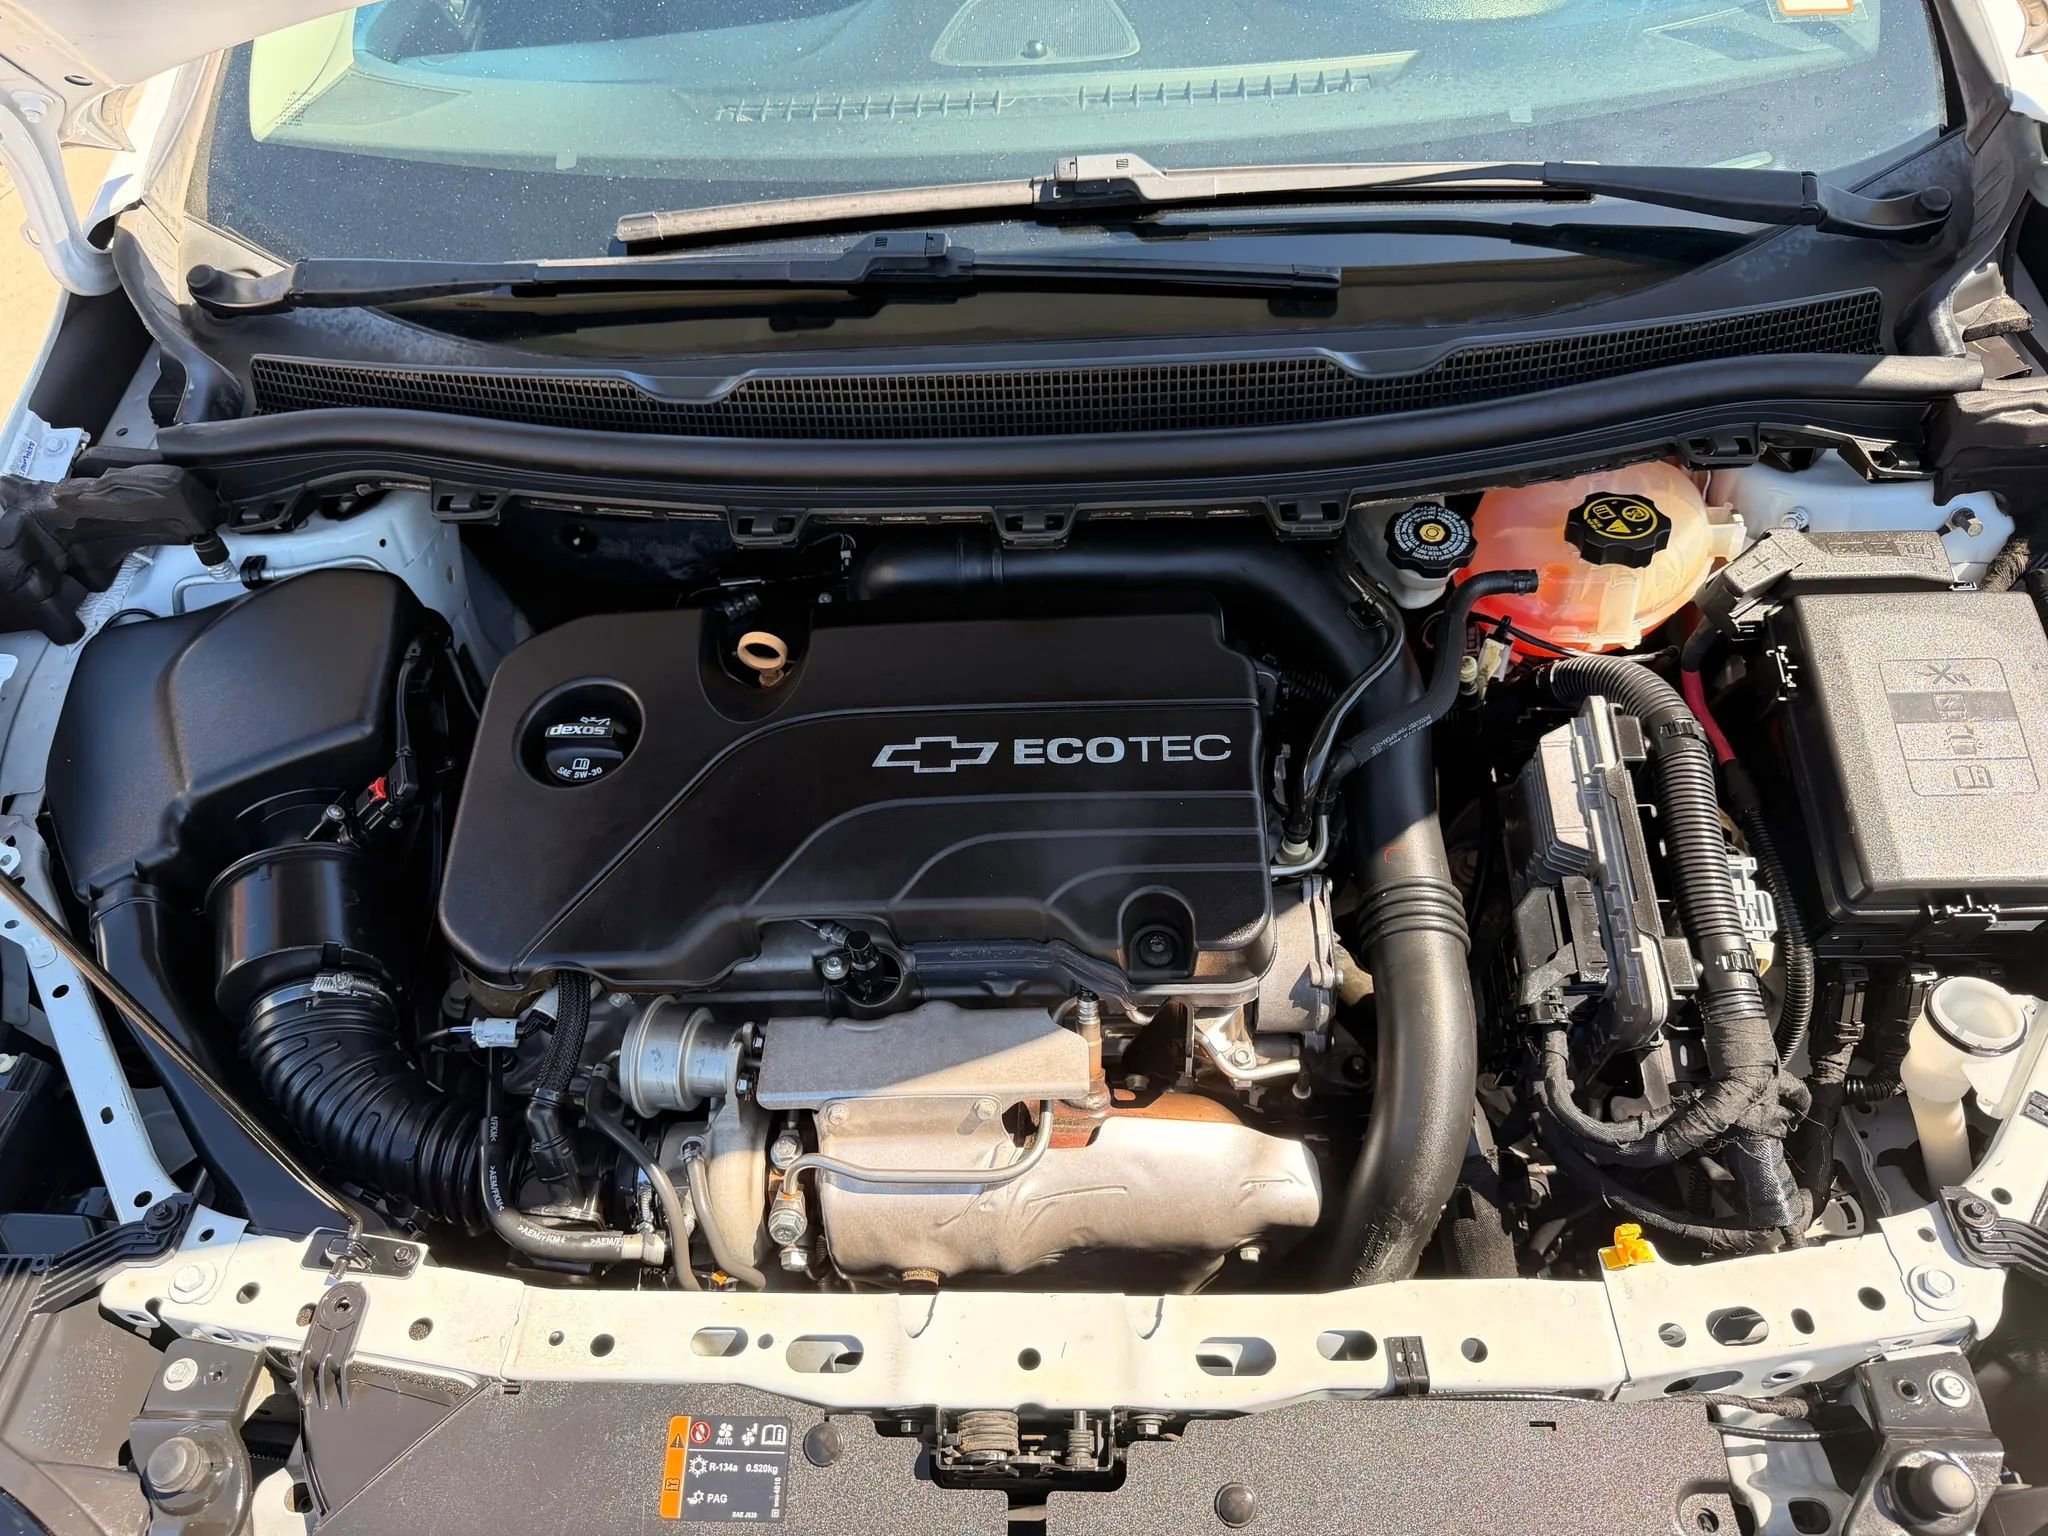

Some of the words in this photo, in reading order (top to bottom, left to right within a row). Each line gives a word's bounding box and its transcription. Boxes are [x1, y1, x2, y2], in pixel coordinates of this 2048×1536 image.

[549, 724, 606, 735] dexos
[1013, 734, 1232, 765] ECOTEC
[556, 766, 572, 778] SAE
[573, 766, 603, 779] 5W-30
[716, 1437, 733, 1446] AUTO
[709, 1462, 738, 1472] R-134a
[745, 1463, 779, 1475] 0.520kg
[706, 1493, 728, 1504] PAG
